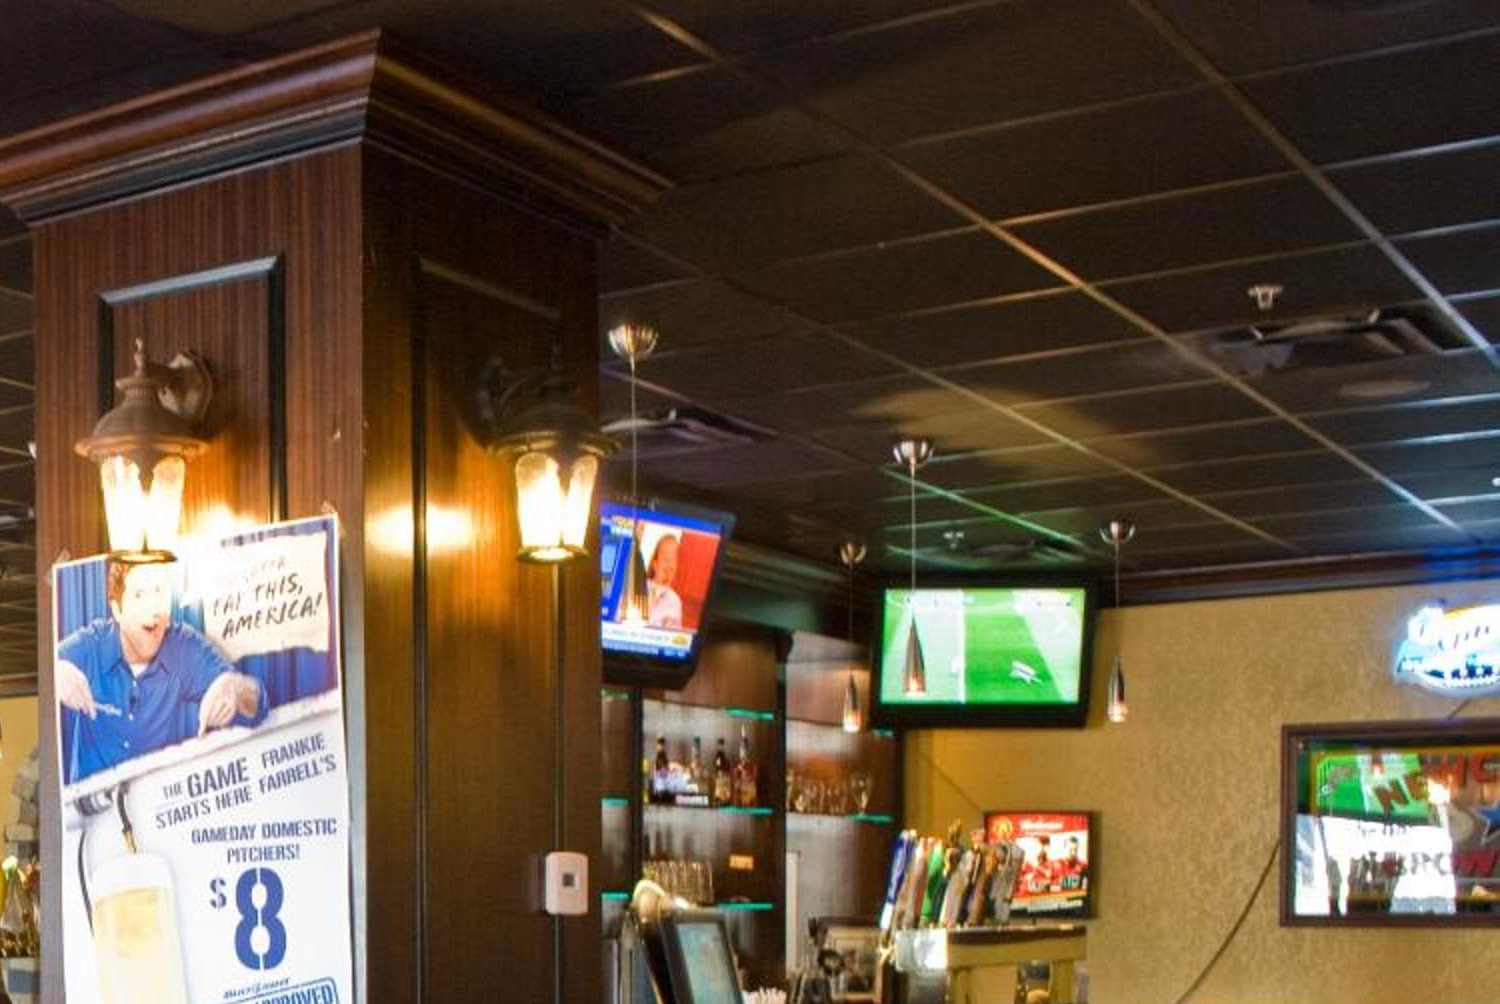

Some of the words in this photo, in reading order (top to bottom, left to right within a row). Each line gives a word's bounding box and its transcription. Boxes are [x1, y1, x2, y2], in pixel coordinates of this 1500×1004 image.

[221, 591, 323, 640] AMERICA!
[261, 732, 325, 769] FRANKIE
[187, 756, 249, 798] GAME
[259, 753, 337, 794] FARRELL'S
[155, 799, 212, 830] STARTS
[215, 786, 253, 811] HERE
[191, 823, 257, 845] GAMEDAY
[261, 818, 338, 840] DOMESTIC
[227, 843, 300, 864] PITCHERS!
